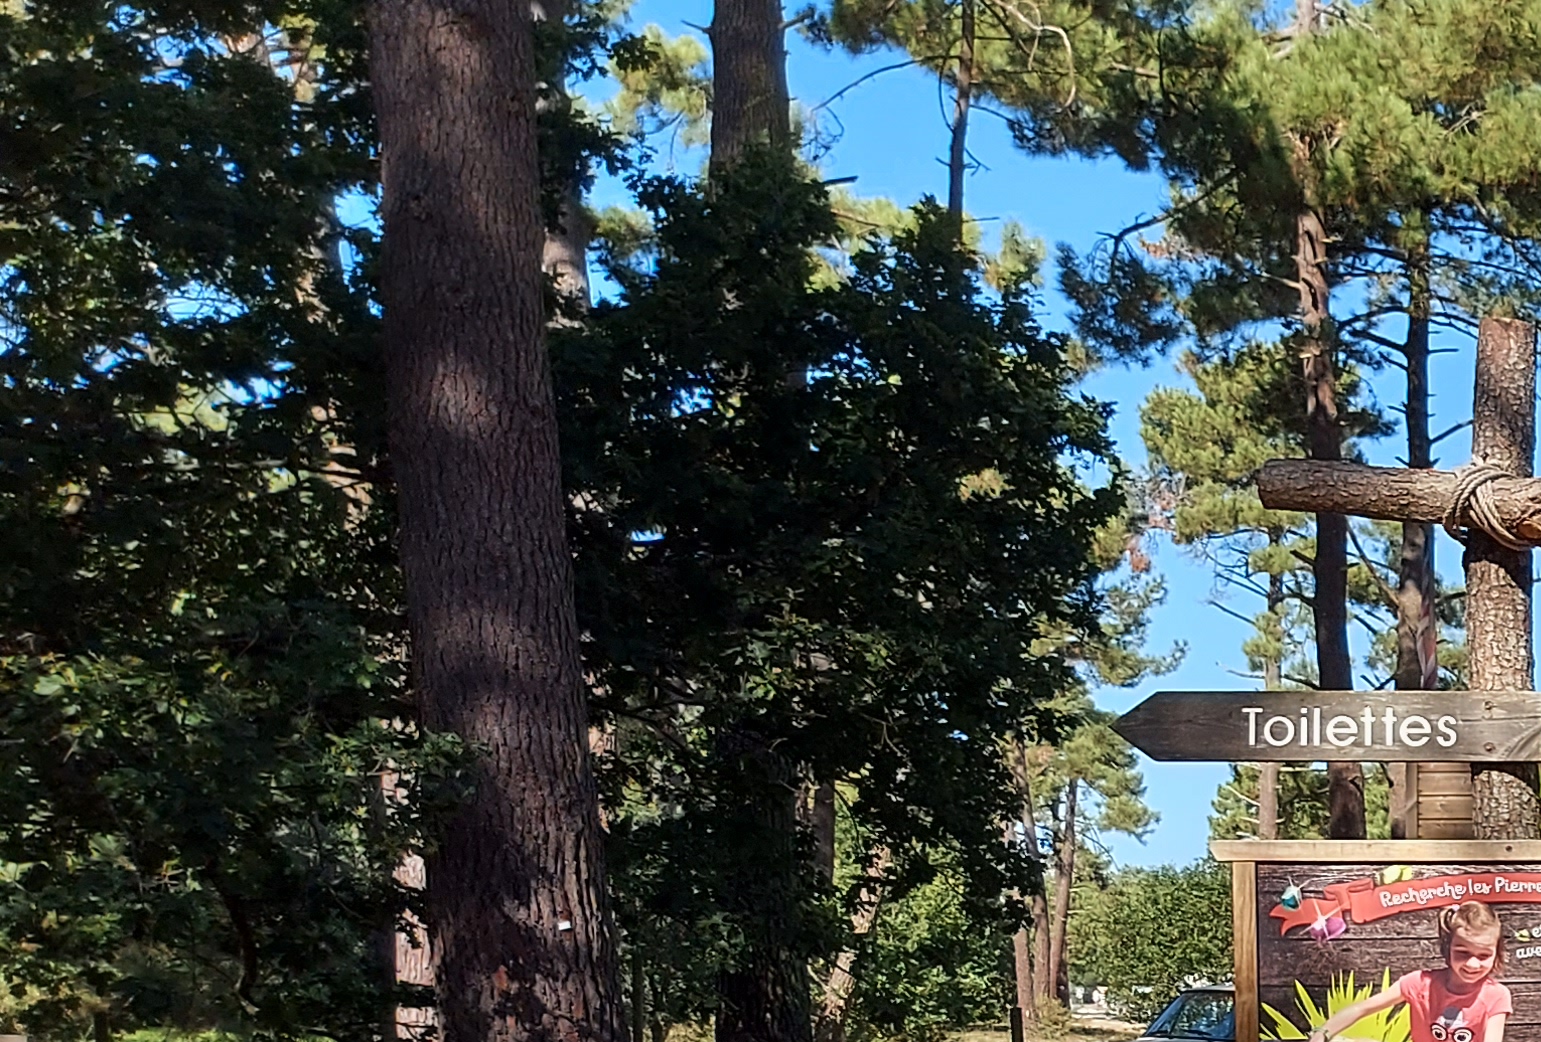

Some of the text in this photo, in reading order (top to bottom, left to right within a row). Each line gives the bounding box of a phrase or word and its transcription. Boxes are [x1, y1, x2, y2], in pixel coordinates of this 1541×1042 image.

[1241, 706, 1458, 747] Toilettes
[1379, 880, 1466, 907] Recherche
[1468, 878, 1491, 897] les
